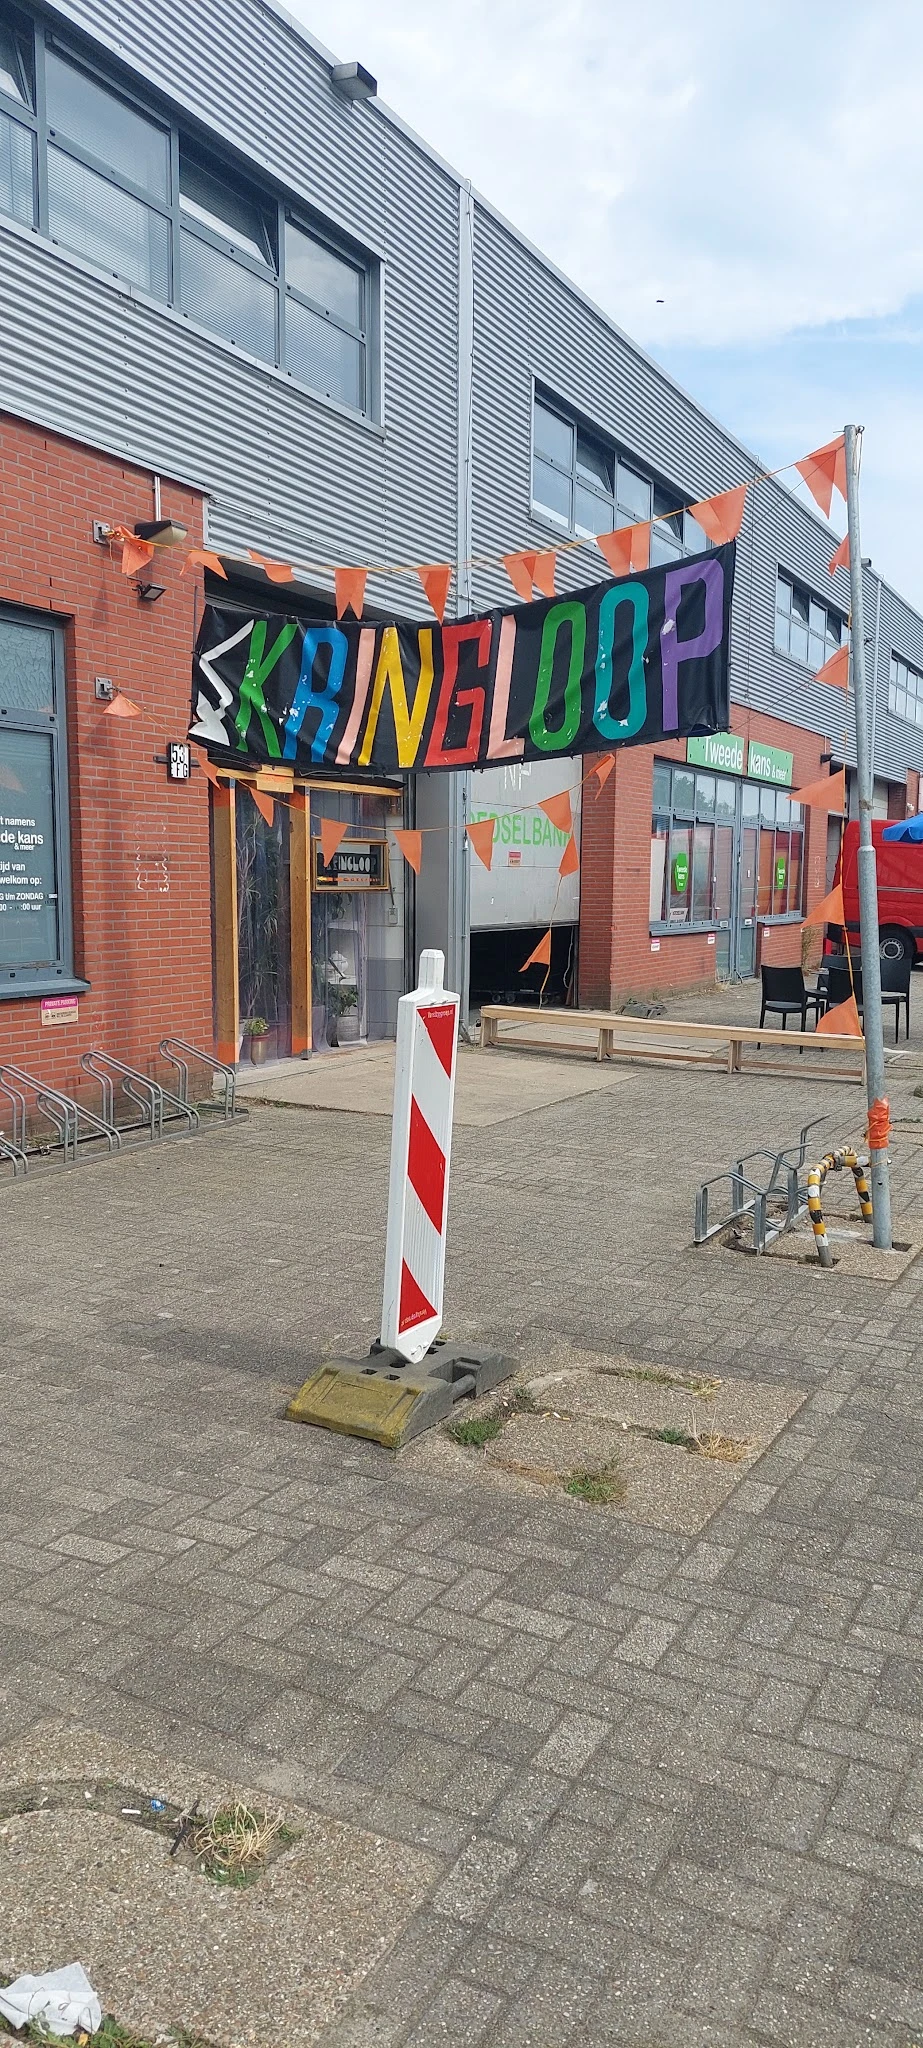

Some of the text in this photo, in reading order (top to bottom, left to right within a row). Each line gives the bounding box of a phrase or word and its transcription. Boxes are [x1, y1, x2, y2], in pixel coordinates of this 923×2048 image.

[234, 558, 725, 768] KRINGLOOP
[171, 744, 185, 763] 53
[704, 735, 744, 770] Tweede
[750, 746, 772, 777] kans
[4, 817, 36, 827] namens
[17, 831, 44, 845] kans
[14, 843, 20, 851] &
[11, 863, 26, 871] van
[0, 875, 42, 887] welkom op:
[16, 892, 44, 901] ZONDAG
